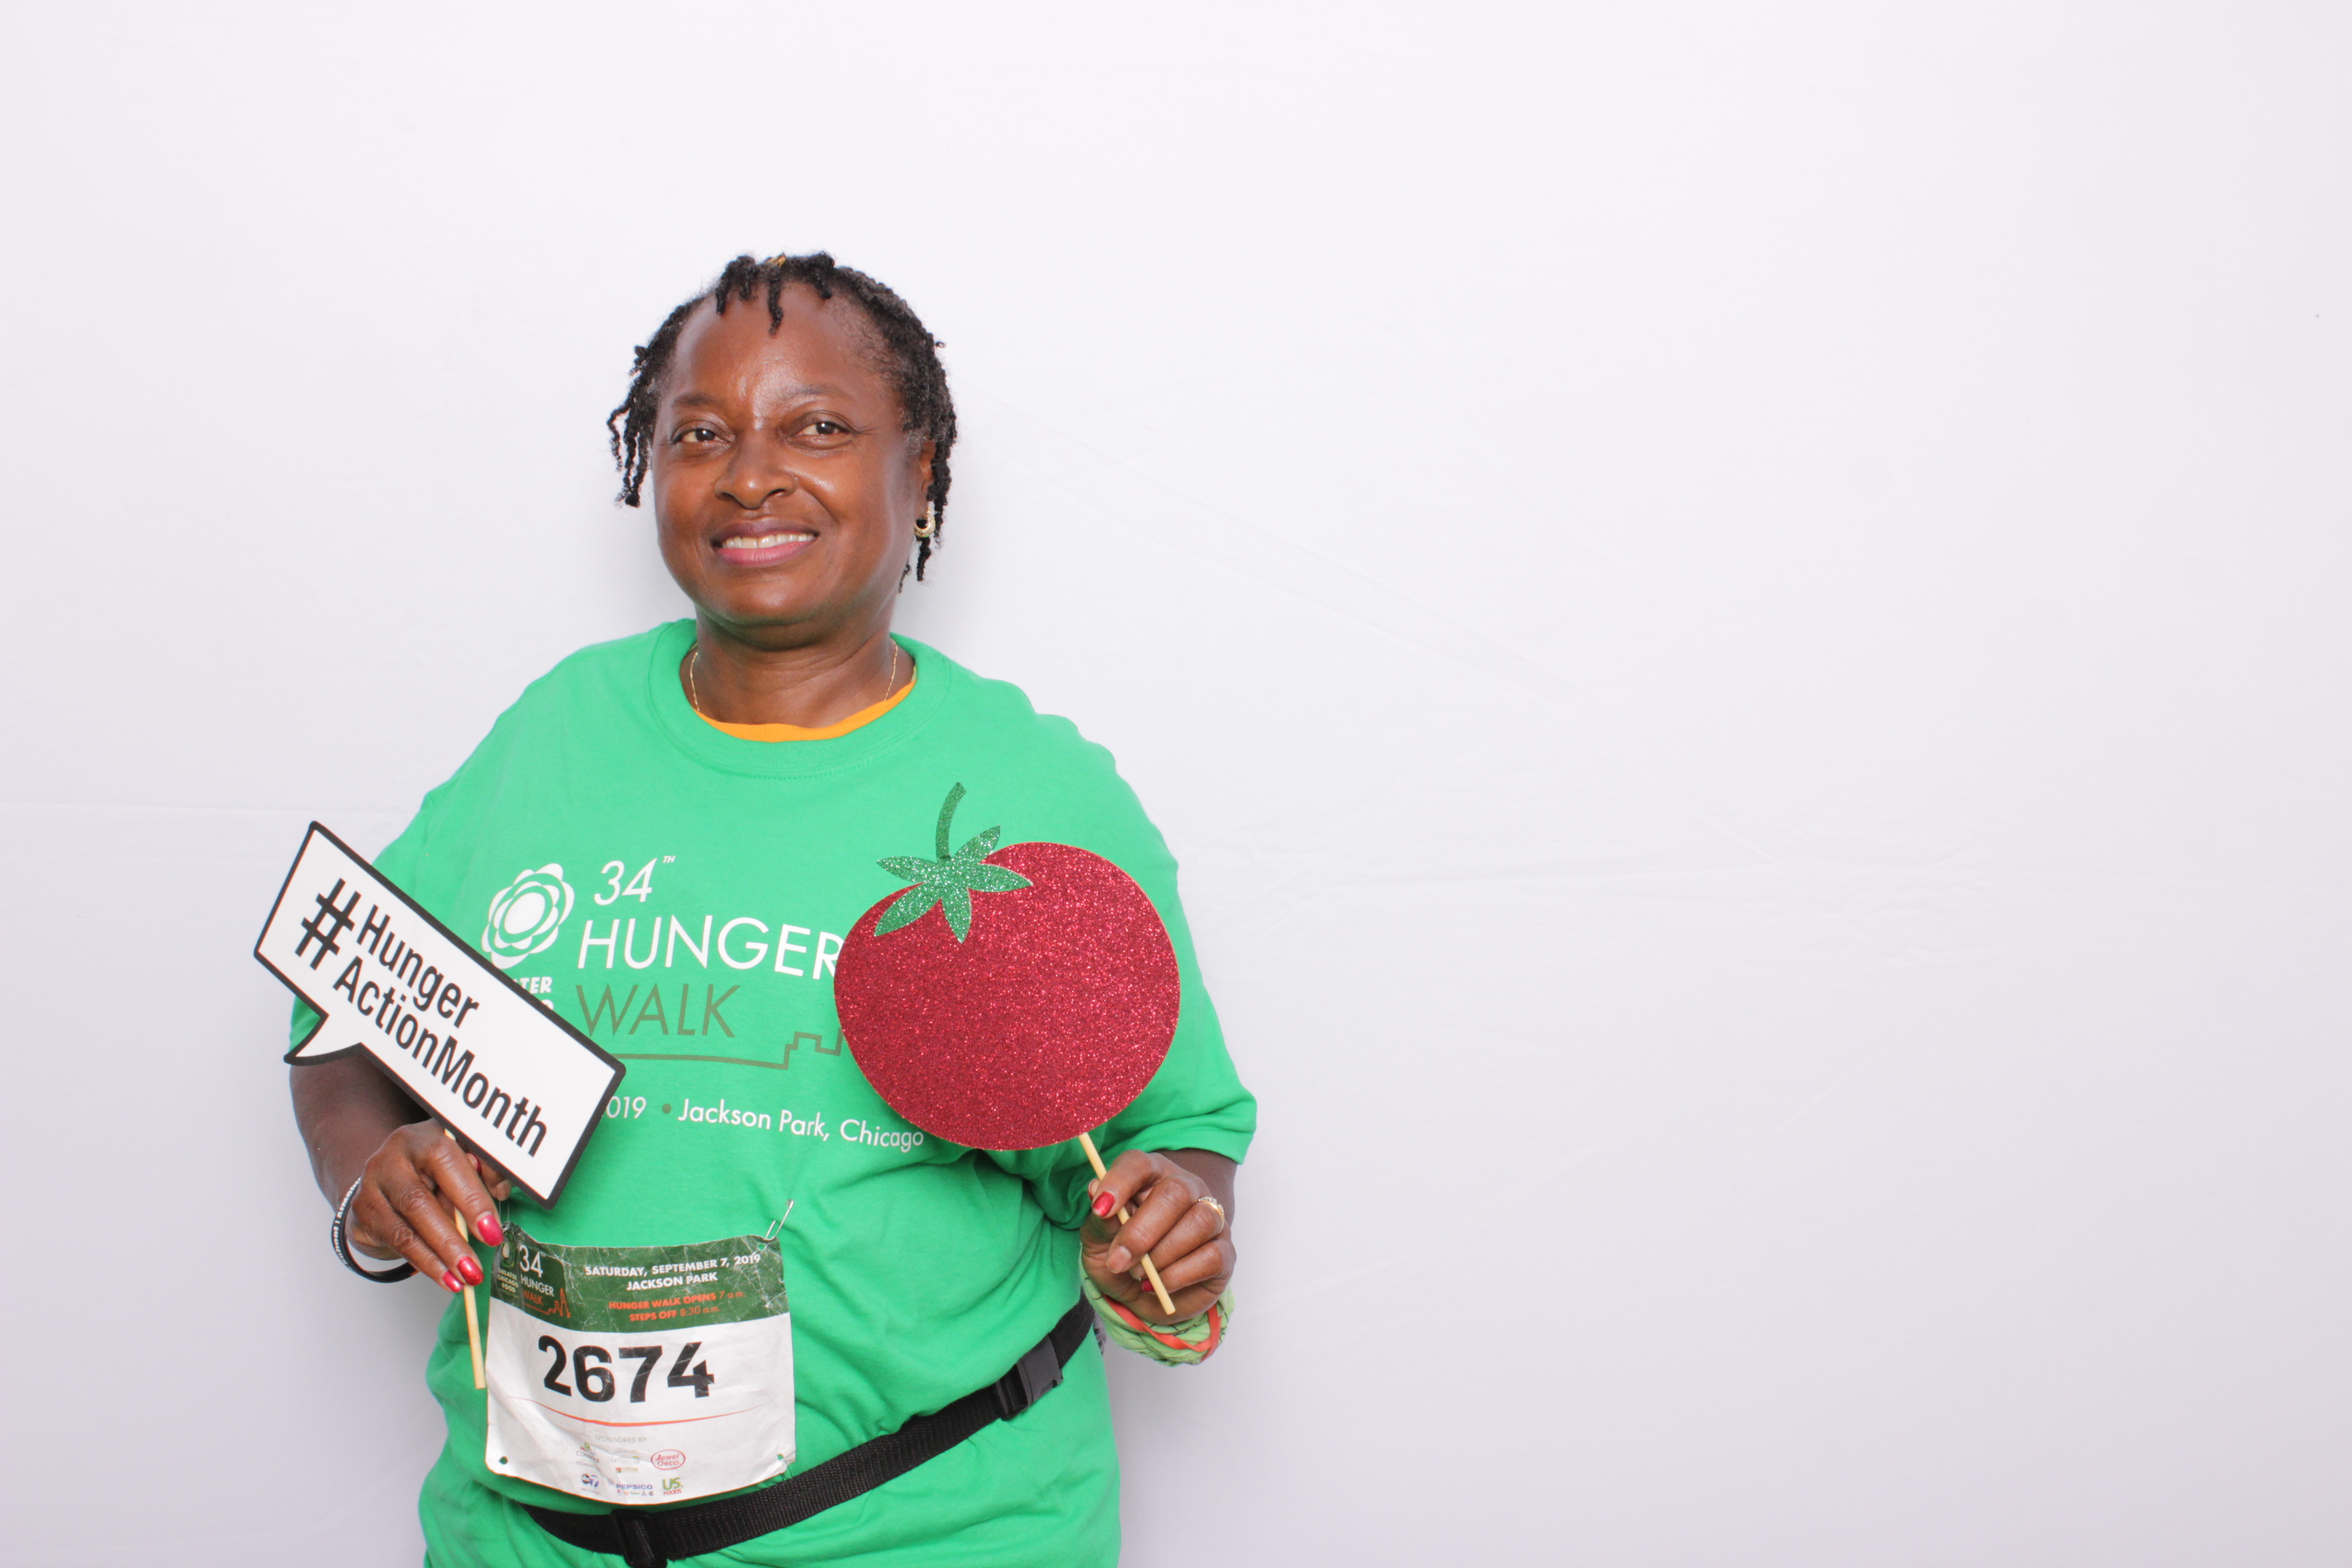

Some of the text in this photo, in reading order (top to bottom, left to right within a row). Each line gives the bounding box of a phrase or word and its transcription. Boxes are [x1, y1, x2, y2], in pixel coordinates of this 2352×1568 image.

[295, 878, 479, 1028] #Hunger
[577, 915, 844, 980] HUNGER
[575, 983, 741, 1039] WALK
[332, 956, 547, 1158] ActionMonth
[602, 1096, 924, 1153] 019 Jackson Park, Chicago
[585, 1254, 761, 1277] SATURDAY, SEPTEMBER 7, 2019
[501, 1282, 516, 1293] FOOD
[521, 1274, 555, 1297] HUNGER
[626, 1272, 718, 1291] JACKSON PARK
[523, 1290, 544, 1306] WALK
[608, 1301, 650, 1310] HUNGER
[652, 1297, 681, 1308] WALK
[683, 1292, 717, 1305] OPENS
[719, 1291, 725, 1299] 7
[630, 1312, 657, 1322] STEPS
[659, 1310, 677, 1320] OFF
[538, 1335, 715, 1403] 2674
[595, 1435, 636, 1443] SPONSORED
